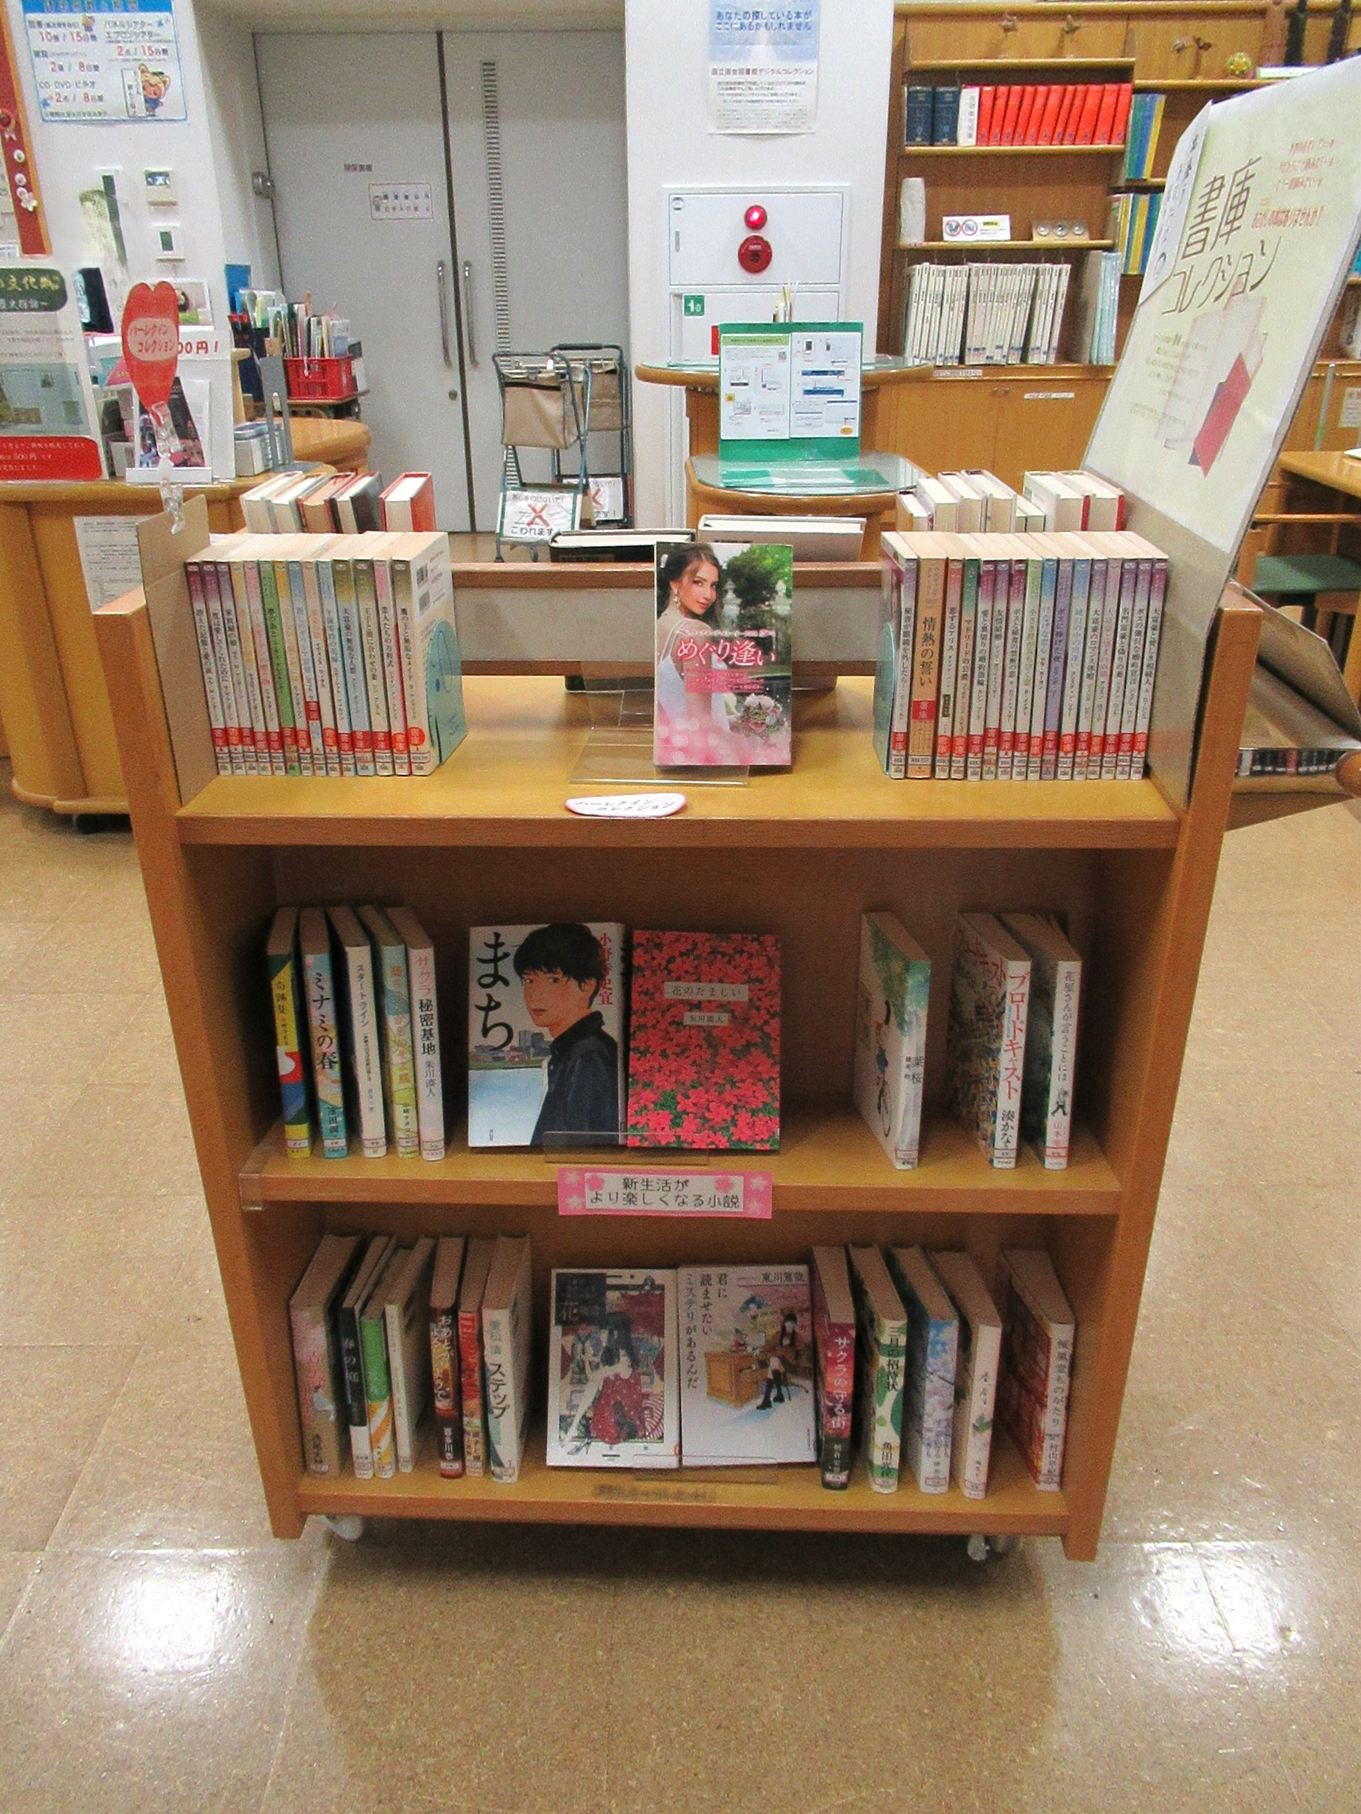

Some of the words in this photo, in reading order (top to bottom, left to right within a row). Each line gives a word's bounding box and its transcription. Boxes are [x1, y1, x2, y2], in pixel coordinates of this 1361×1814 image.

[1181, 156, 1263, 260] 書庫
[1161, 235, 1282, 315] コレクション
[677, 638, 776, 666] めぐり逢い
[918, 616, 937, 687] 情熱の誓い
[311, 972, 339, 1070] ミナミの春
[356, 964, 369, 1028] スタートライン
[416, 955, 437, 1056] サクラ秘密基地
[474, 932, 514, 1051] まち
[671, 985, 743, 998] 花のたましい
[1057, 970, 1077, 1082] 花屋さんが言うことには
[1002, 971, 1030, 1100] ブロードキャスト
[424, 1060, 436, 1098] 朱川湊人
[589, 1191, 741, 1209] より楽しくなる小説
[622, 1178, 690, 1193] 新生活が
[699, 1274, 714, 1336] 読ませたい
[717, 1273, 728, 1299] 君に
[683, 1274, 698, 1390] ミステリがあるんだ
[886, 1325, 900, 1393] 三月の招待状
[488, 1362, 510, 1419] ステップ
[830, 1336, 851, 1430] サクラの守る街
